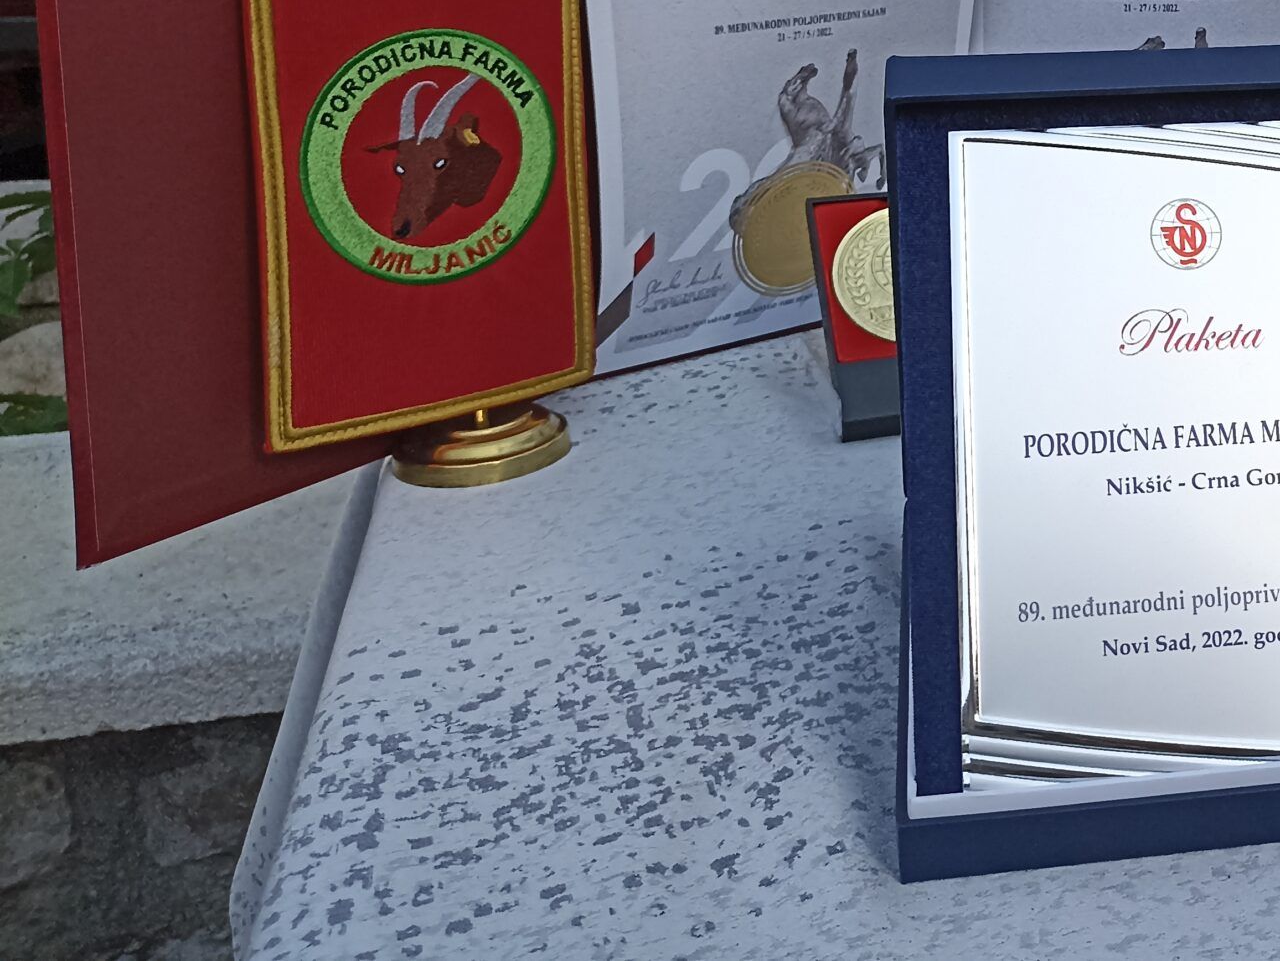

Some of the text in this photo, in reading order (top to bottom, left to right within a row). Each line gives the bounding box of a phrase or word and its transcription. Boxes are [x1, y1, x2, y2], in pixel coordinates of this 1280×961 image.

[1123, 3, 1132, 12] 21
[1139, 3, 1147, 12] 27
[319, 38, 535, 131] PORODIČNA FARMA
[367, 220, 512, 275] MILJANIĆ
[1119, 309, 1265, 356] Plaketa
[1024, 424, 1167, 458] PORODIČNA
[1174, 422, 1255, 448] FARMA
[1107, 475, 1172, 496] Nikšić
[1192, 473, 1240, 489] Crna
[1019, 602, 1045, 622] 89.
[1052, 590, 1184, 619] međunarodni
[1103, 637, 1149, 656] Novi
[1156, 633, 1196, 656] Sad,
[1202, 629, 1248, 648] 2022.
